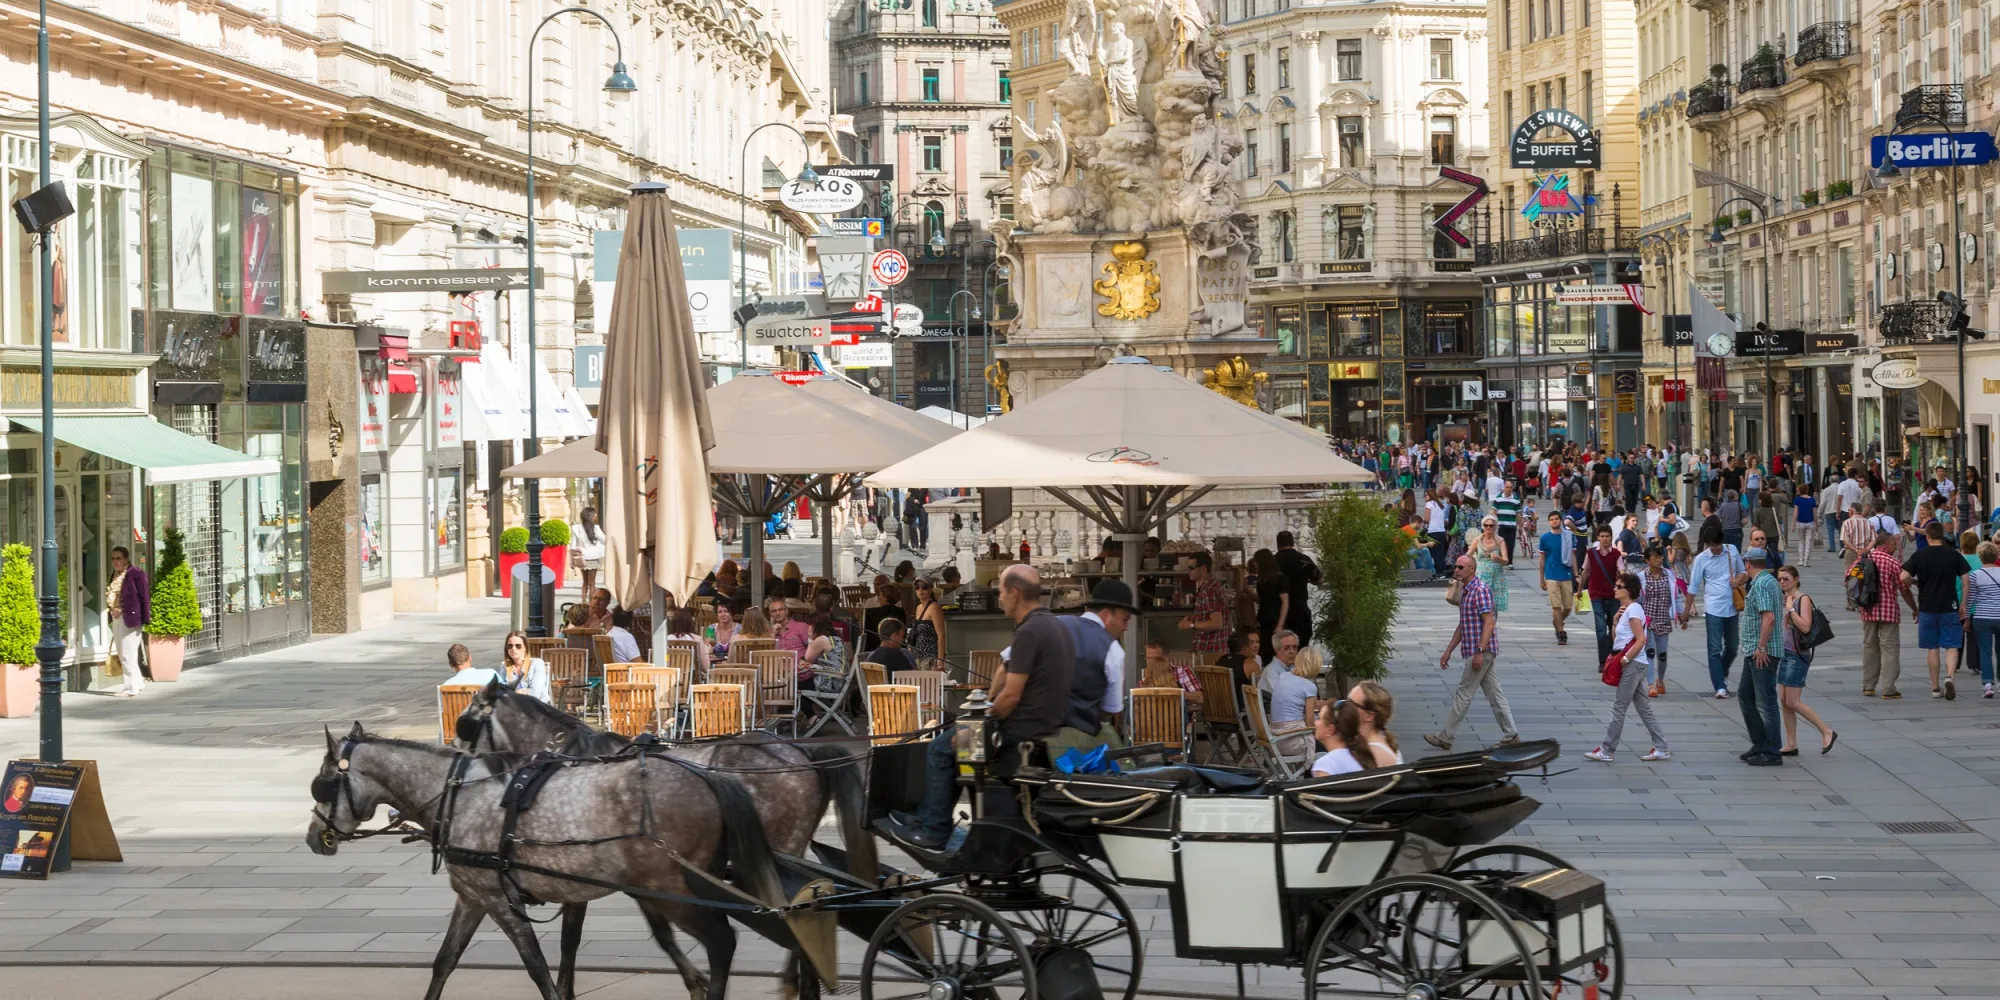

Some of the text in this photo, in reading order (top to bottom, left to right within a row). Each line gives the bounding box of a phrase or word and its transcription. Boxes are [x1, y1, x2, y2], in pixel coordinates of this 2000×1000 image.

[1531, 144, 1578, 156] BUFFET
[1888, 137, 1977, 161] Berlitz
[833, 222, 862, 231] BESIM
[368, 276, 502, 287] kornmesser
[755, 325, 811, 339] swatch
[920, 328, 954, 337] OMEGA
